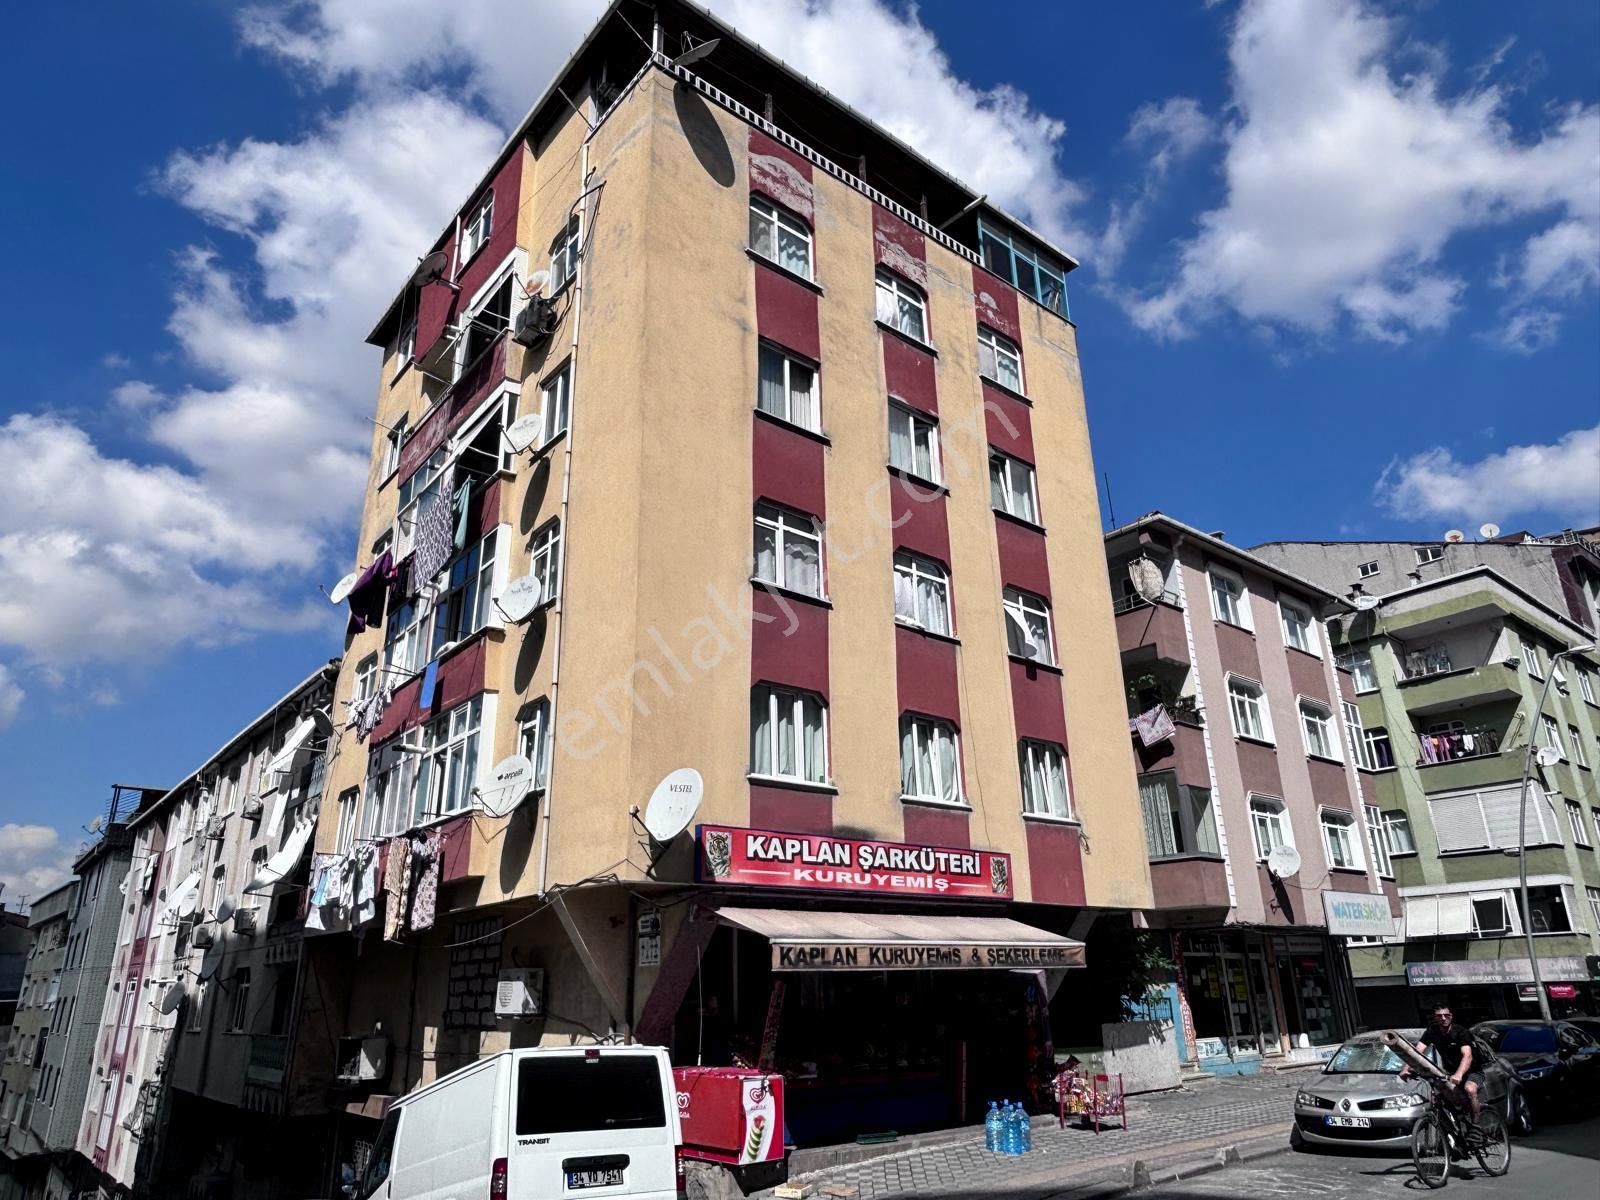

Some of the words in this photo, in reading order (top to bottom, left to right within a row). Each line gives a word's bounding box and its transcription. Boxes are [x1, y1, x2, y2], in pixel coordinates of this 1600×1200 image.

[669, 783, 693, 793] VESTEL
[746, 835, 851, 865] KAPLAN
[858, 844, 981, 875] ŞARKÜTERİ
[793, 868, 949, 891] KURUYEMİŞ
[780, 946, 858, 966] KAPLAN
[971, 948, 981, 962] &
[1341, 1117, 1353, 1126] EMB
[1357, 1118, 1369, 1127] 214
[517, 1138, 551, 1146] TRANSIT
[573, 1173, 584, 1184] 34
[602, 1169, 621, 1181] 7541
